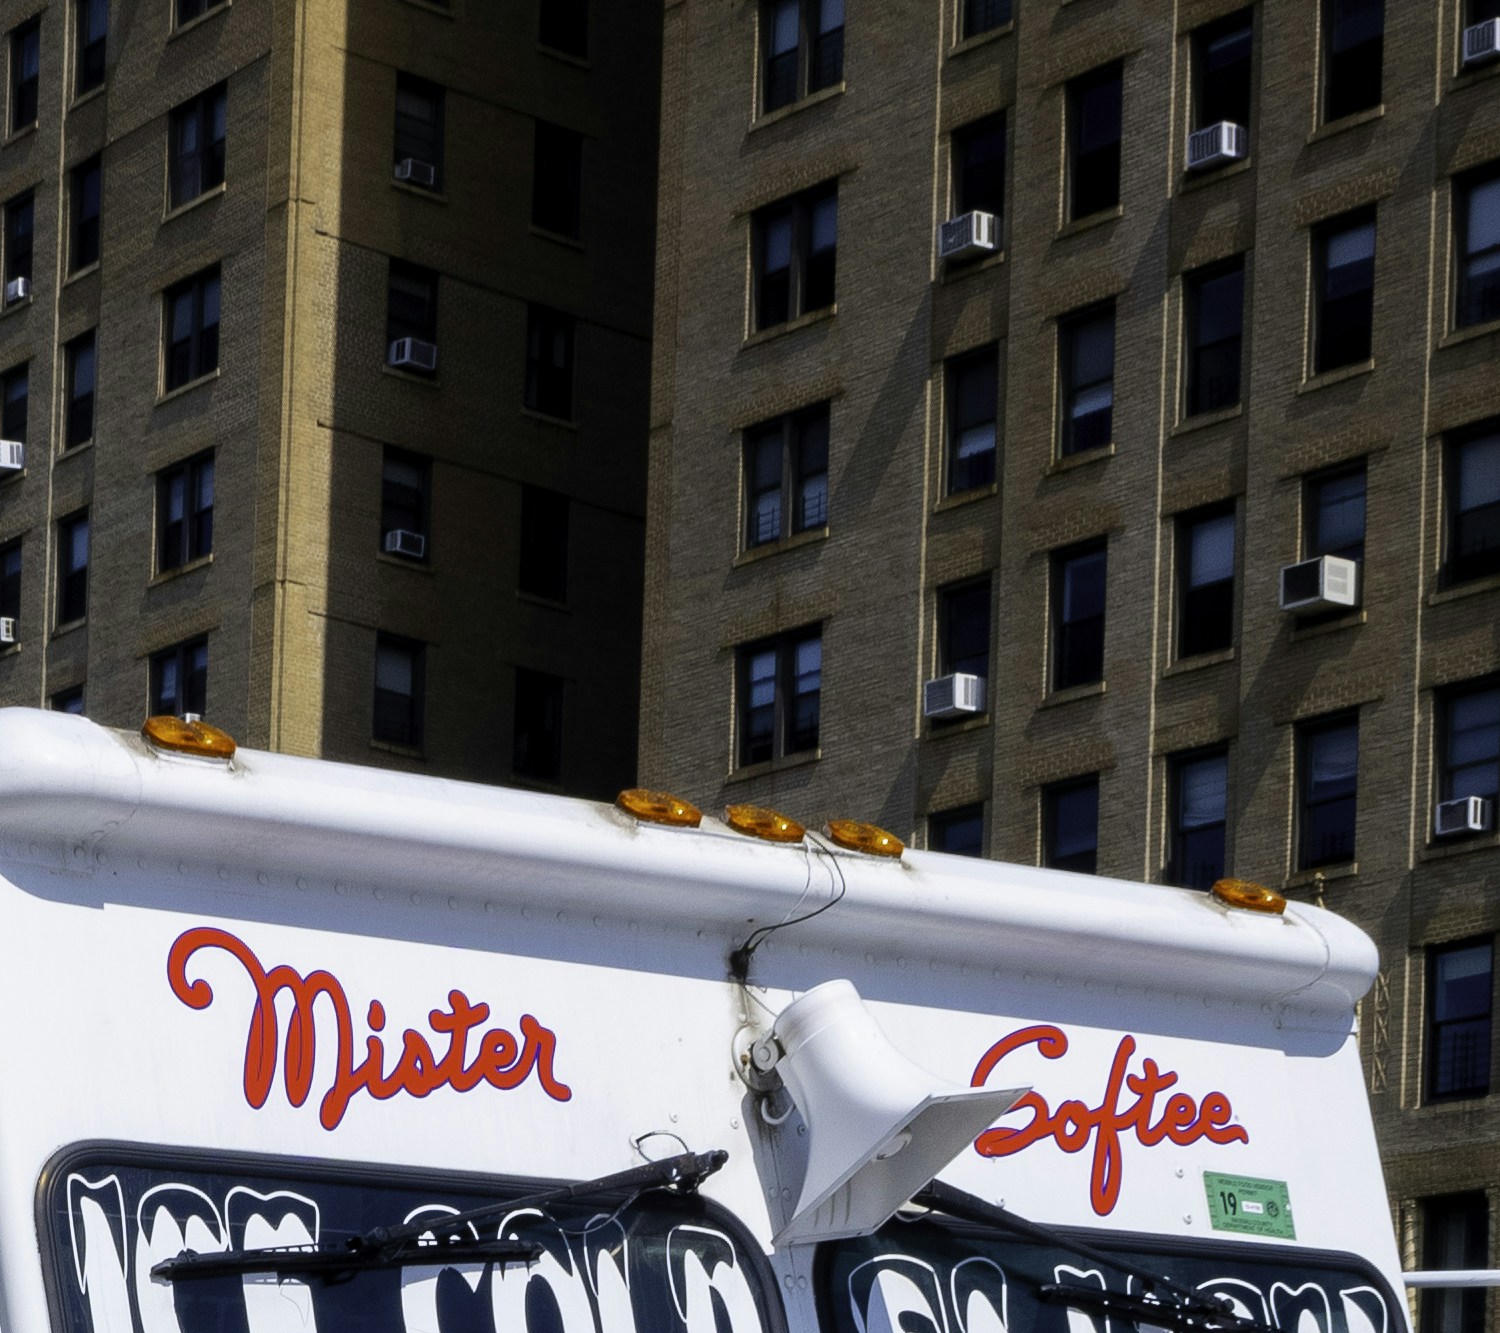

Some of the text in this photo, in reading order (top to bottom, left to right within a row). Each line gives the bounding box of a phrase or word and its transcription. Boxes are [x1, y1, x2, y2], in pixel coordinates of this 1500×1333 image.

[167, 927, 1249, 1217] Mister Softee
[1219, 1191, 1237, 1216] 19
